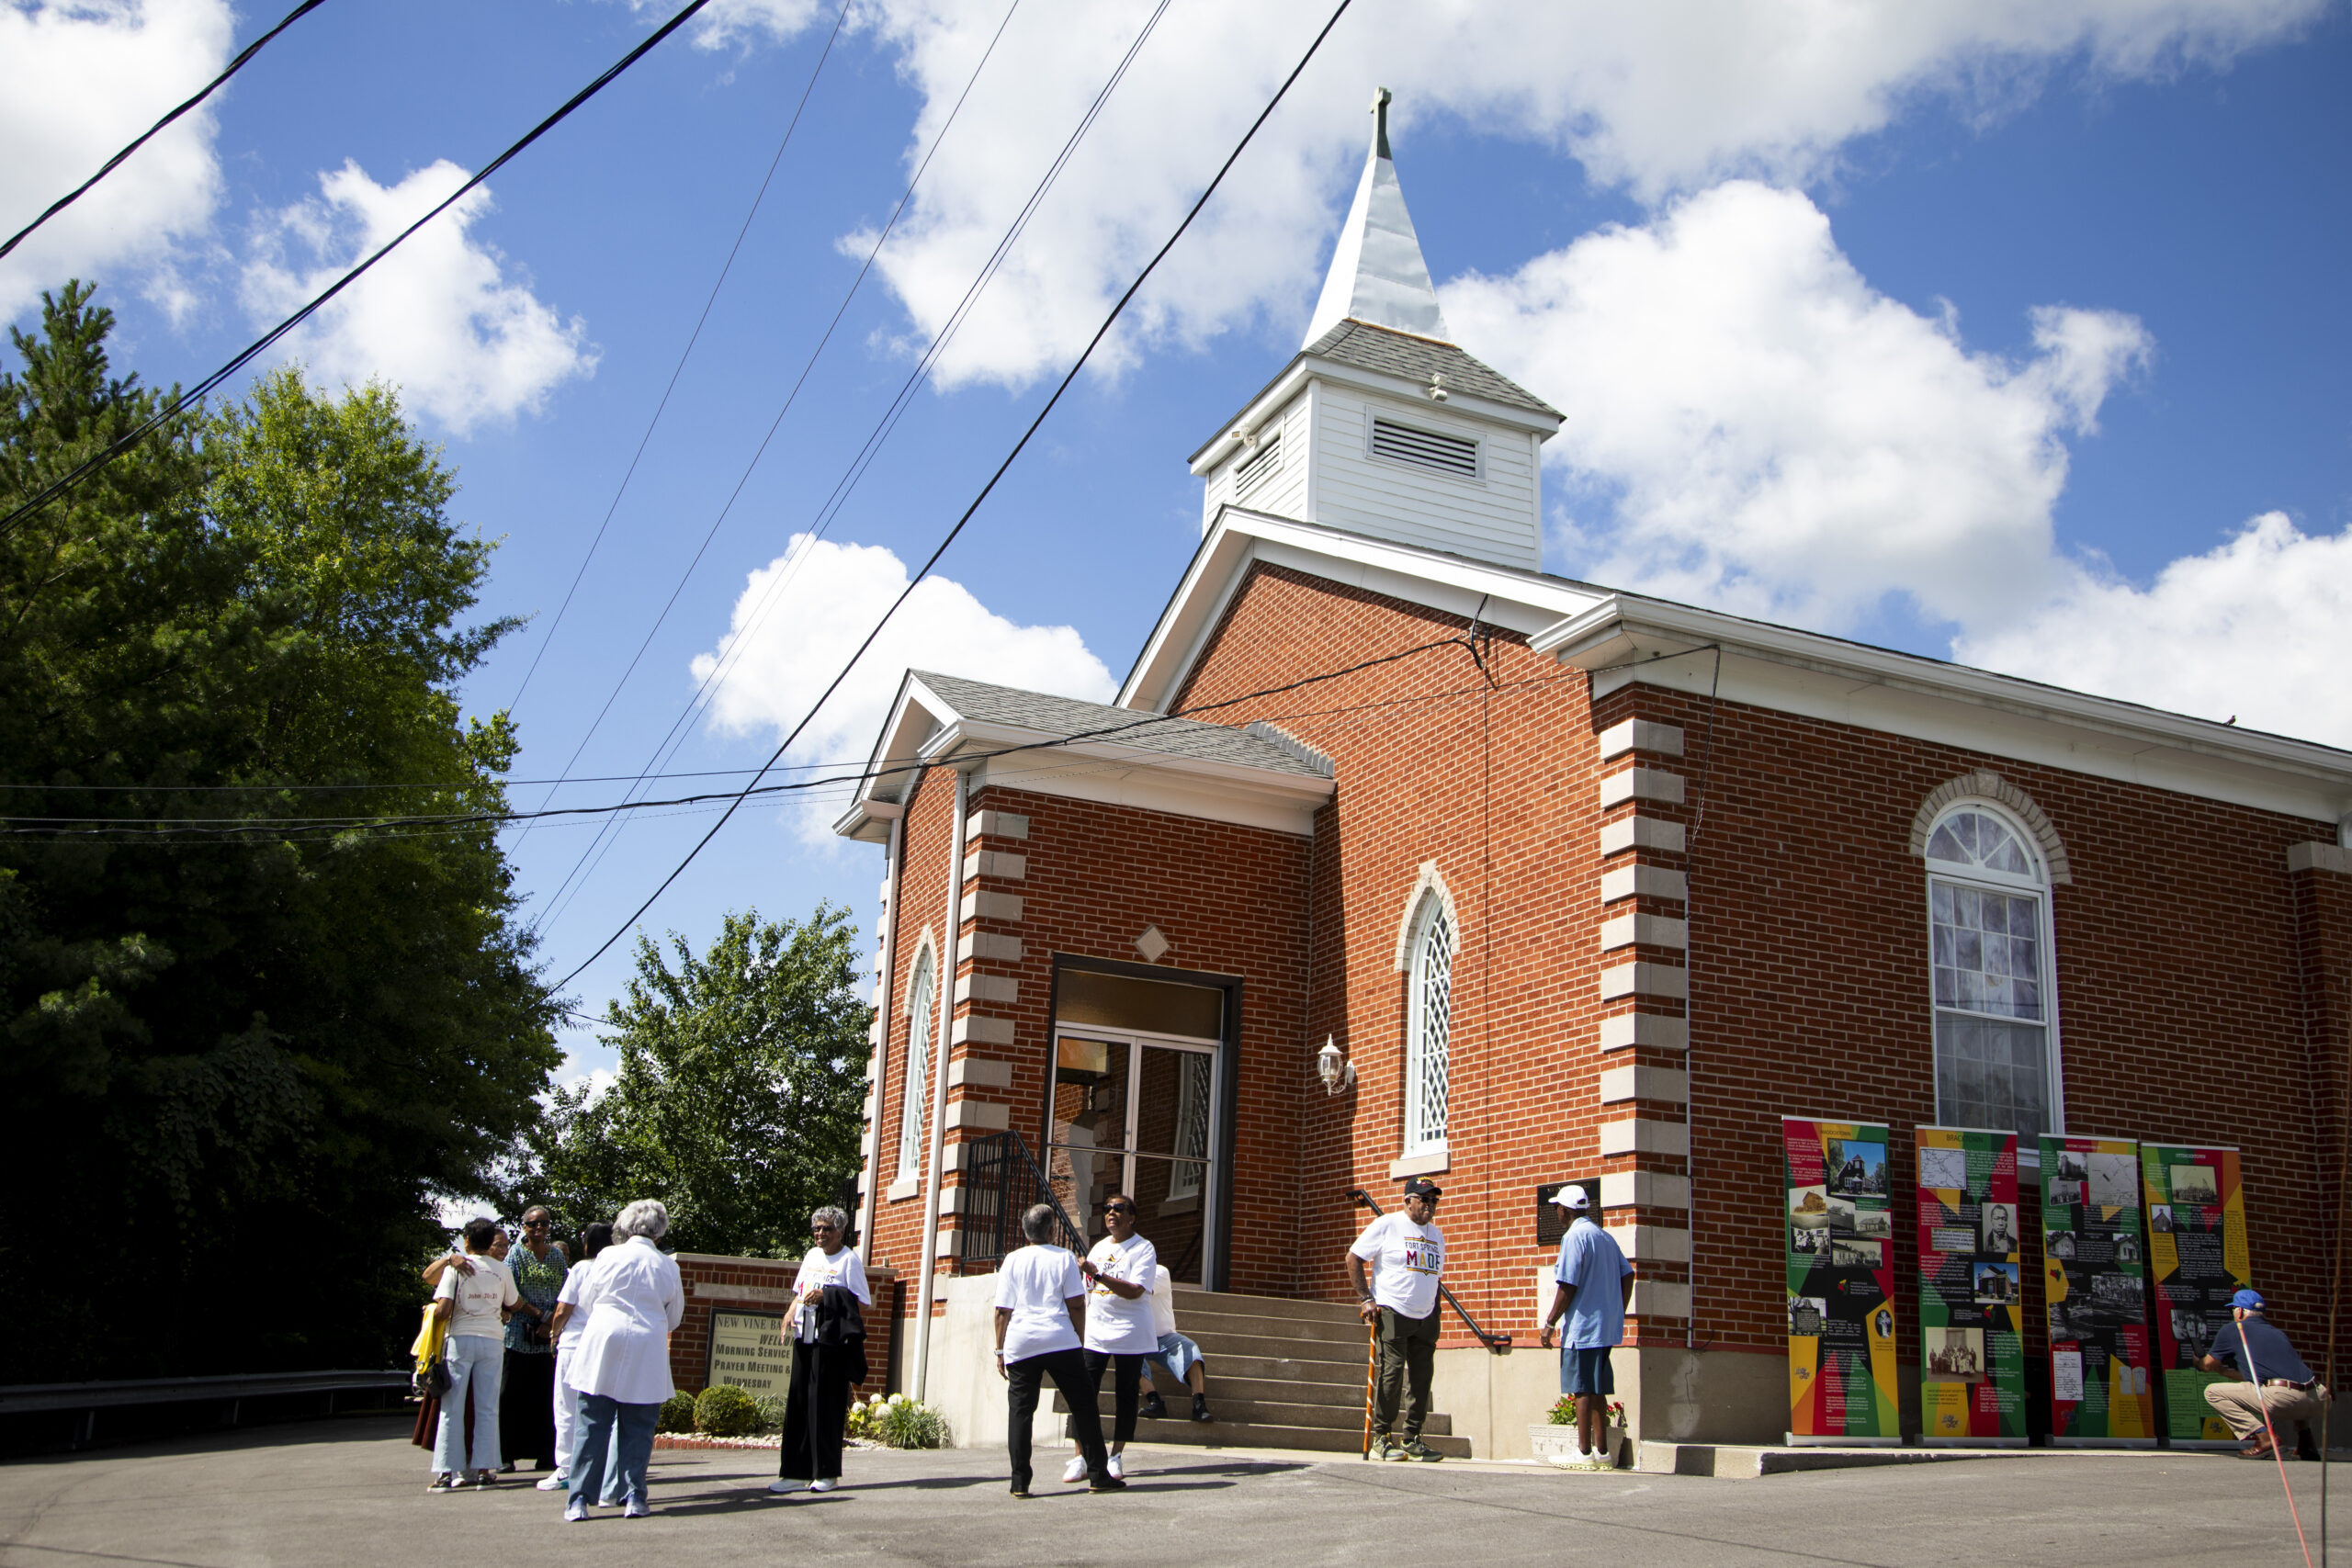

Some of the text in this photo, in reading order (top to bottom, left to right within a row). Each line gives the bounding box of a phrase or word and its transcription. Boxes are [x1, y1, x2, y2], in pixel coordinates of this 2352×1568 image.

[1405, 1241, 1419, 1249] FORT
[1407, 1250, 1441, 1269] MADE
[717, 1316, 739, 1327] NEW
[743, 1317, 766, 1330] VINE
[785, 1365, 791, 1374] &
